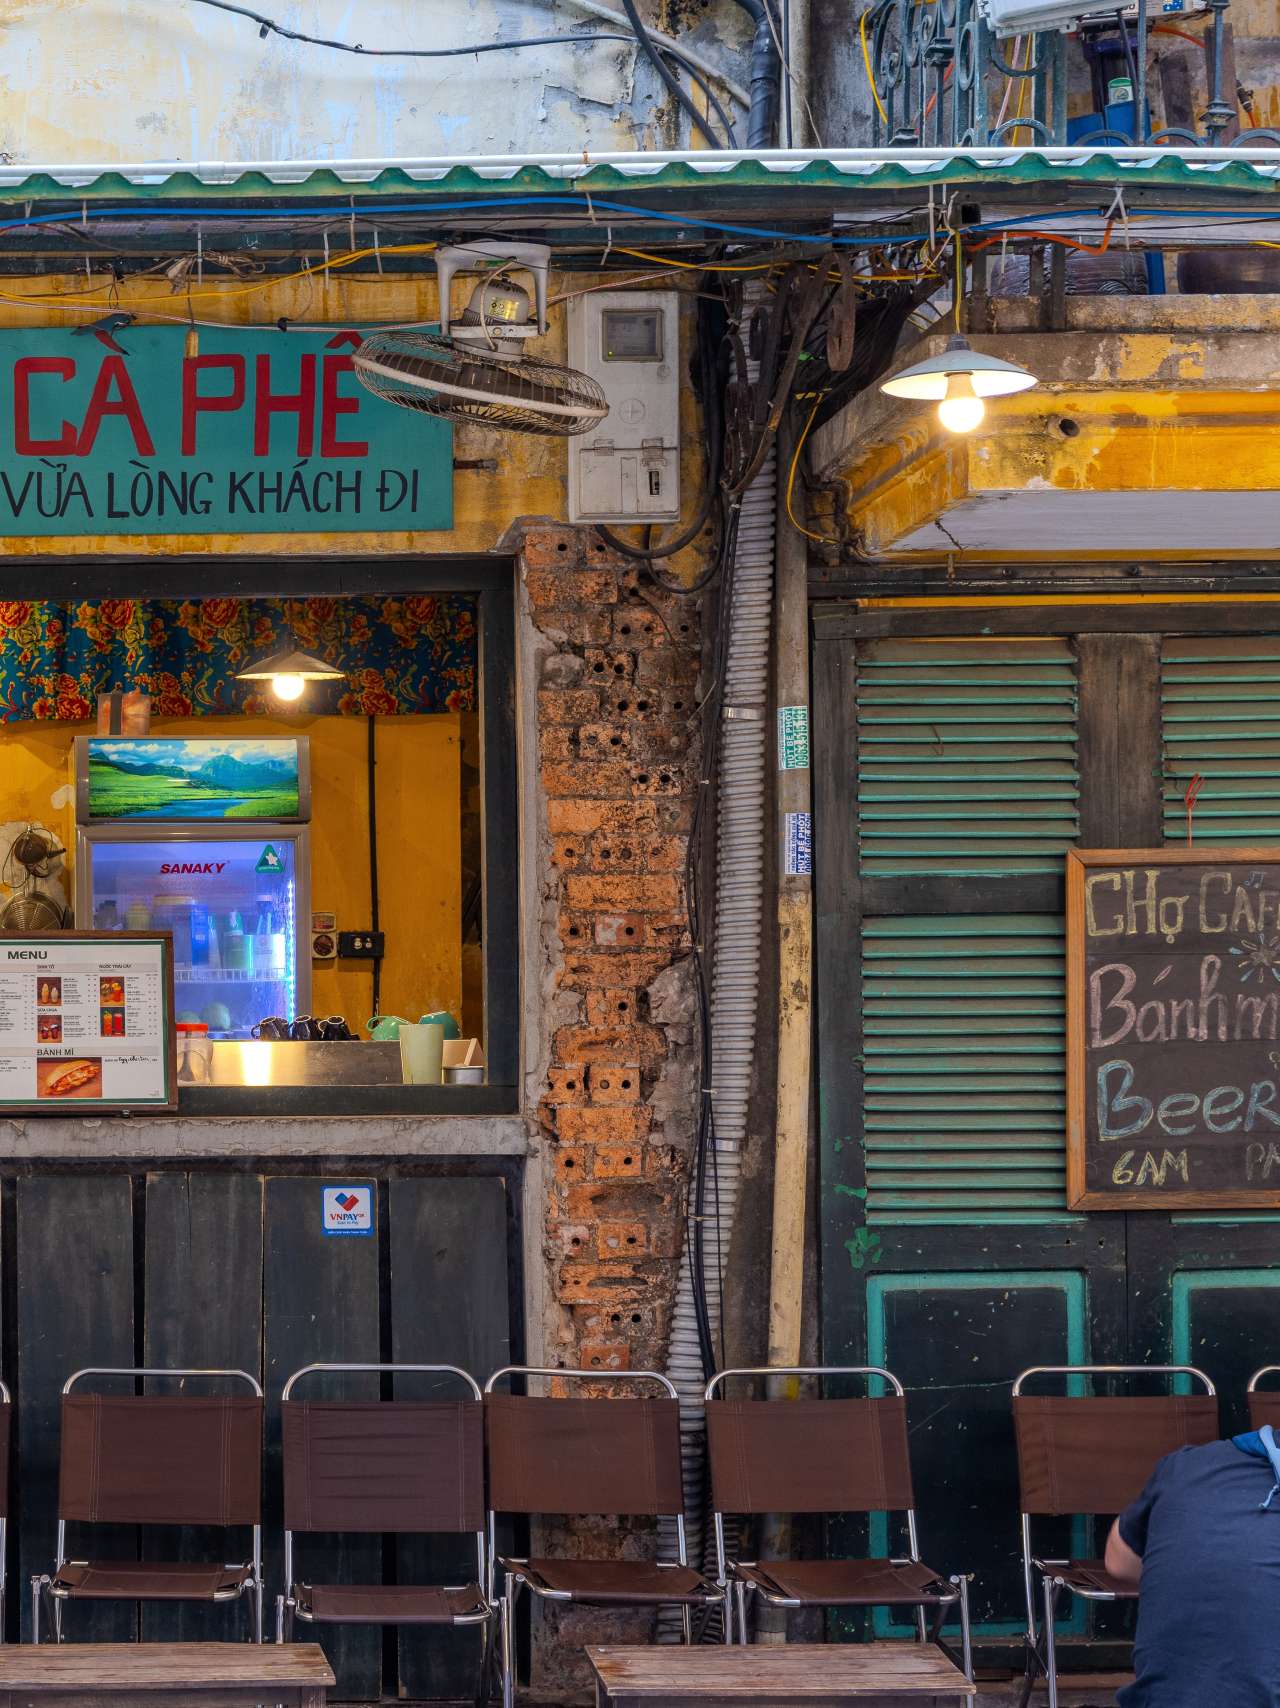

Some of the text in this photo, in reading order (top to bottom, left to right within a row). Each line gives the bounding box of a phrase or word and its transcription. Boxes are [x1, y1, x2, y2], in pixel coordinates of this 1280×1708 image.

[13, 331, 156, 457] CÀ
[181, 331, 370, 458] PHÊ
[107, 460, 214, 519] LÒNG
[228, 458, 362, 517] KHÁCH
[376, 468, 419, 514] ĐI
[160, 863, 226, 874] SANAKY
[1199, 871, 1280, 934] CAF
[7, 950, 48, 960] MENU
[1111, 1147, 1190, 1187] 6AM
